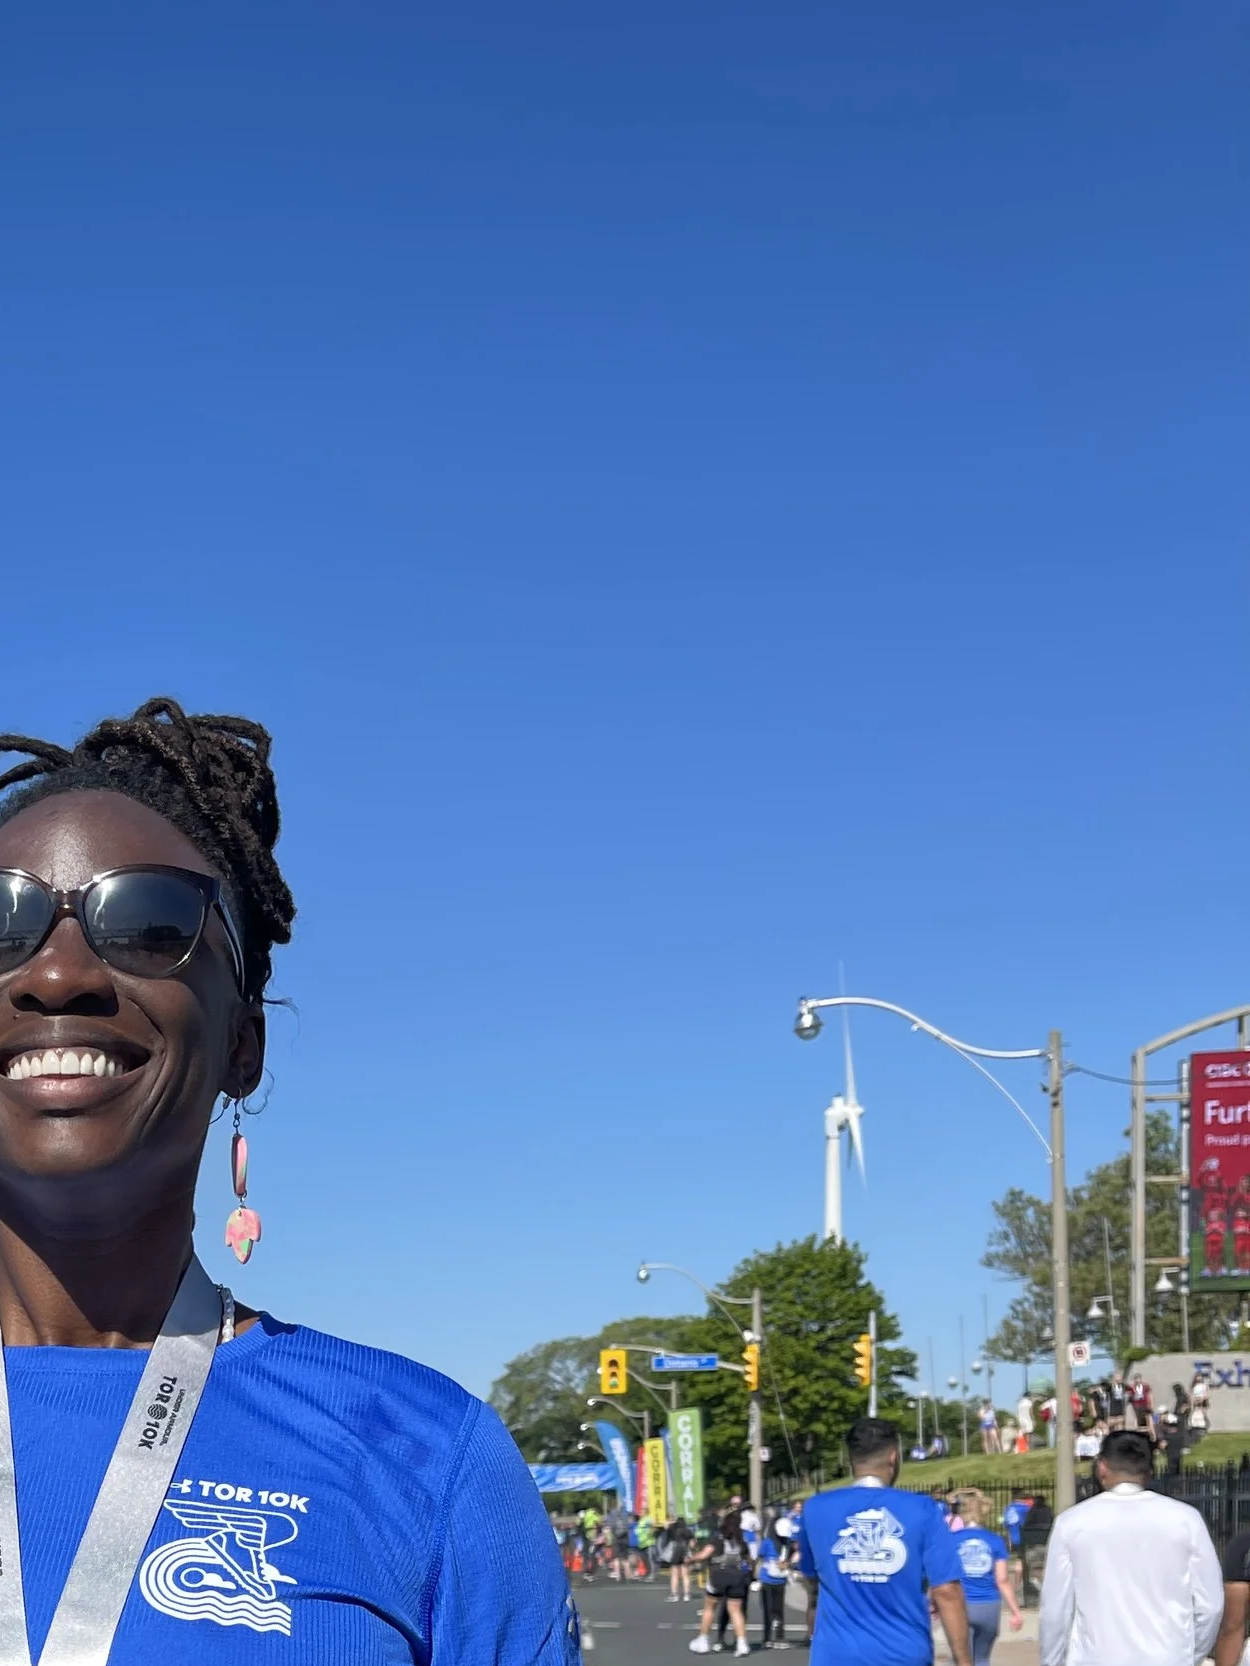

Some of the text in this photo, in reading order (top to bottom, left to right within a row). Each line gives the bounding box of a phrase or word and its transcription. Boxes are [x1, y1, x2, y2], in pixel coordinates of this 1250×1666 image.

[1204, 1099, 1250, 1125] Fur
[138, 1376, 177, 1450] TOR 10K
[677, 1414, 694, 1520] CORRAL
[198, 1480, 310, 1513] TOR 10K
